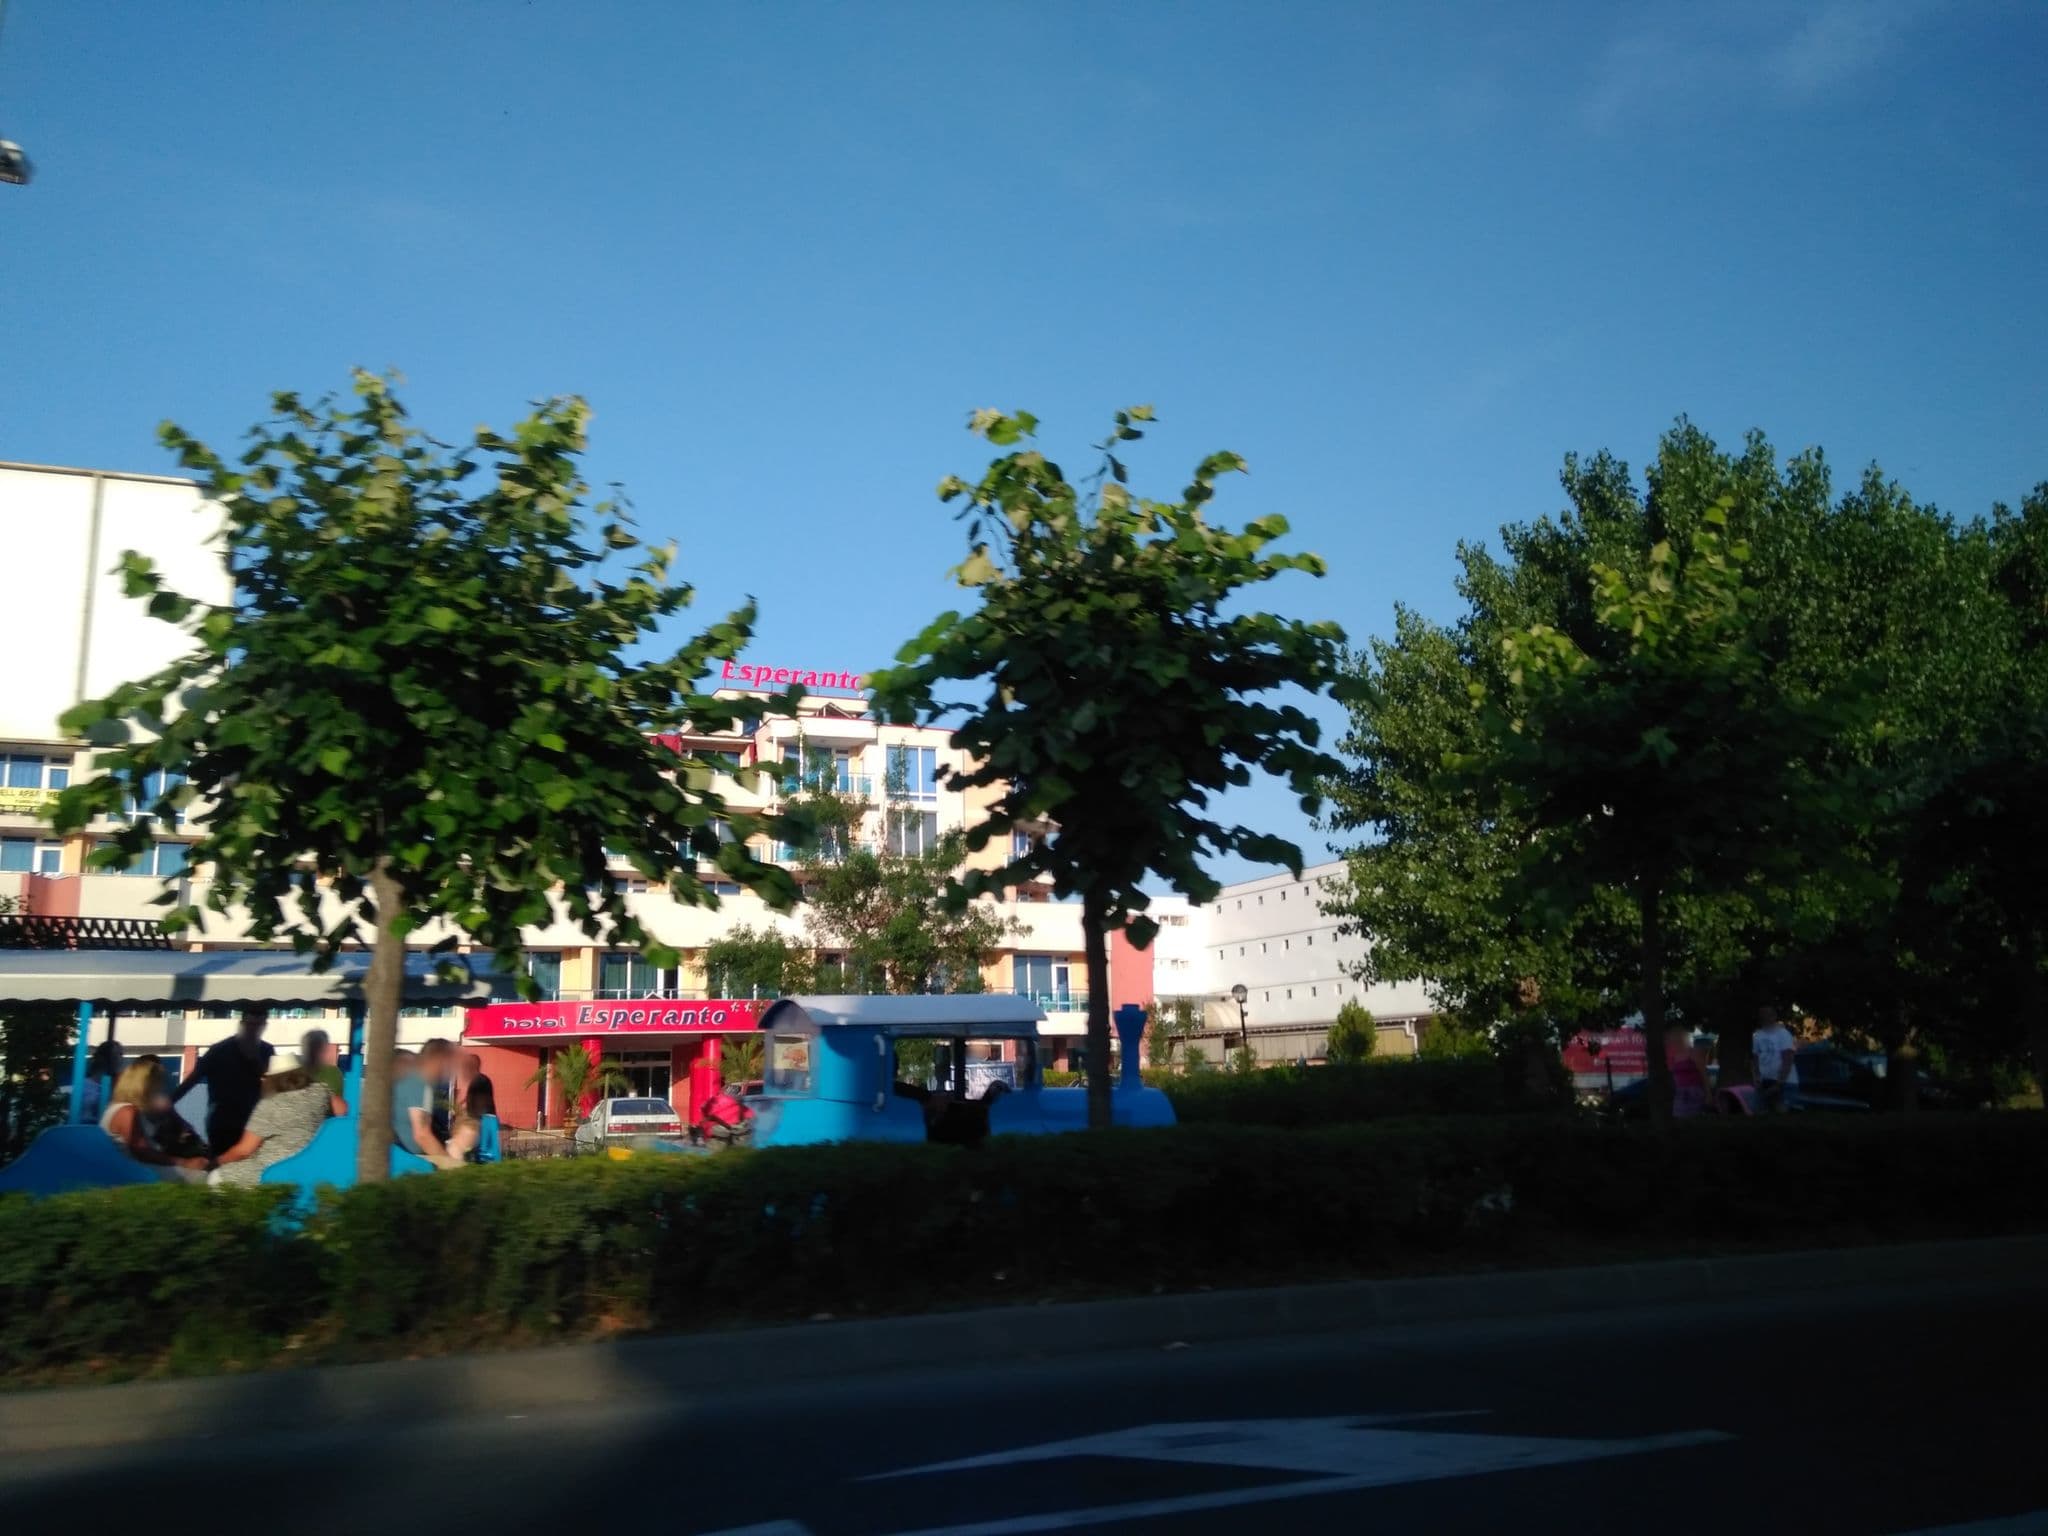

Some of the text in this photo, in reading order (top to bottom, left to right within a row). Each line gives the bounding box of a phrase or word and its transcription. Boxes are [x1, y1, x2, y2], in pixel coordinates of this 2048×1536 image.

[721, 658, 864, 690] Esperanto
[504, 1005, 728, 1030] hotel Esperanto
